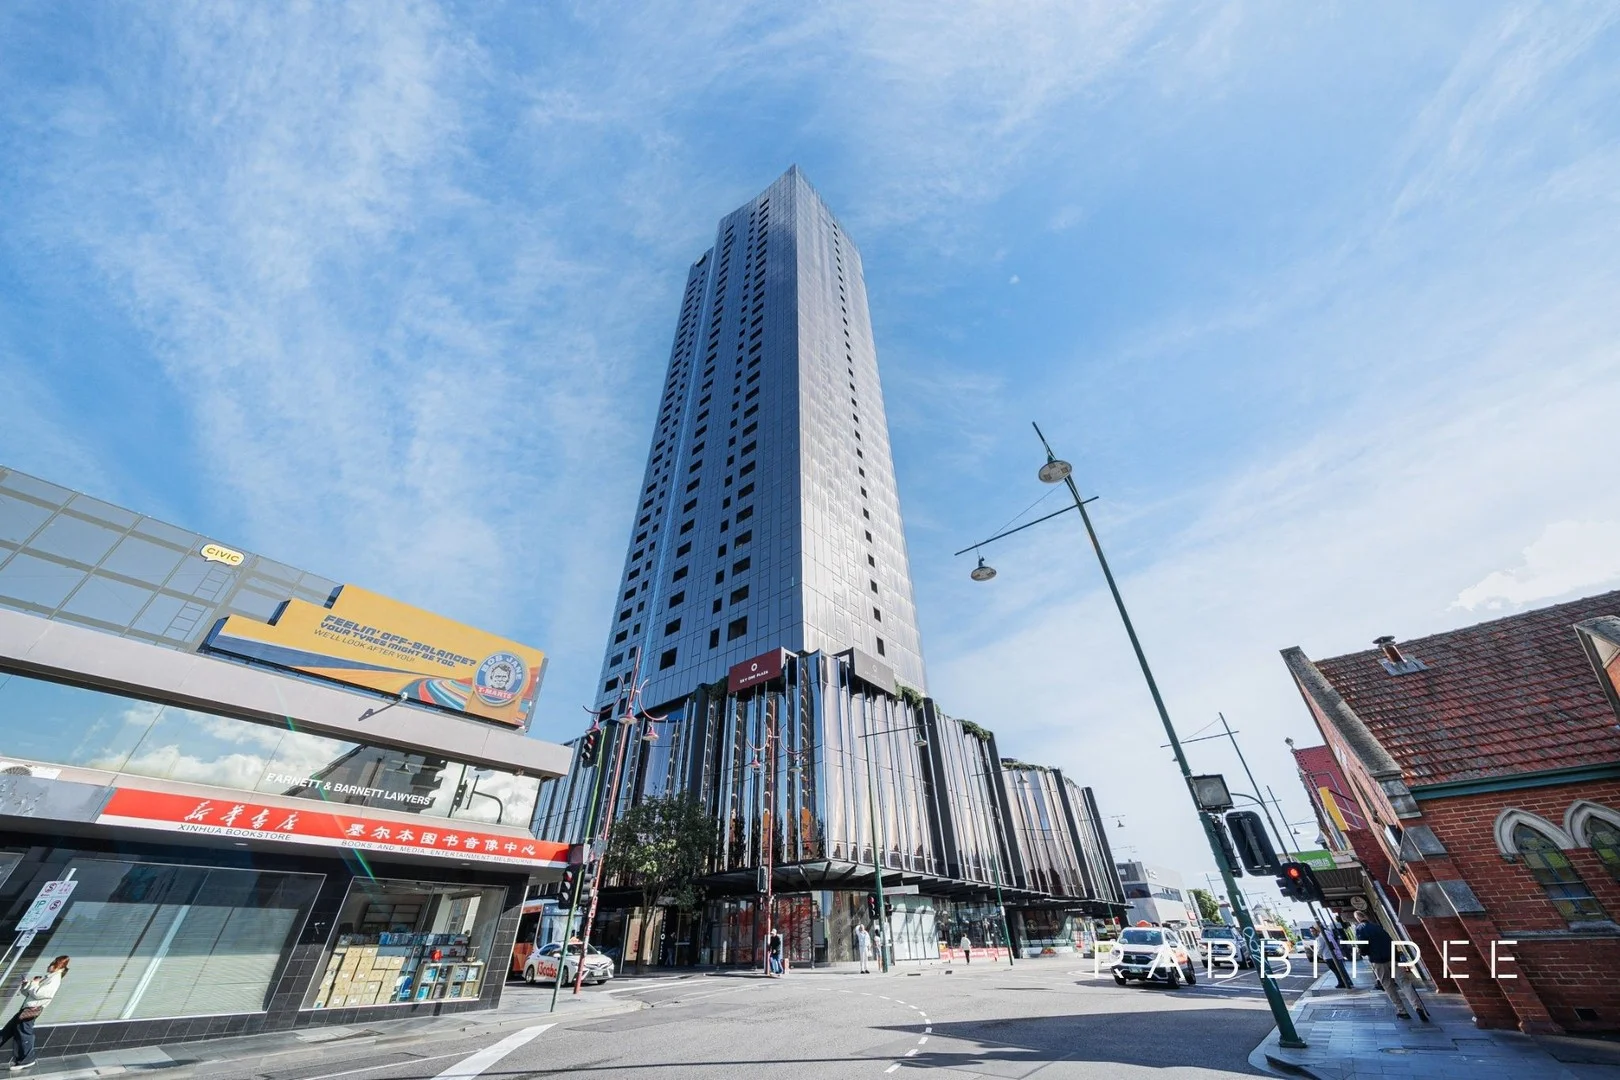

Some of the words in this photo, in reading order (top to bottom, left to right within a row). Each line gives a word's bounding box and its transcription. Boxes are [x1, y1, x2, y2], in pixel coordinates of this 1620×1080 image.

[206, 547, 240, 562] CIVIC
[320, 621, 351, 636] YOUR
[353, 631, 387, 647] TYRES
[388, 642, 421, 656] MIGHT
[421, 653, 435, 661] BE
[436, 656, 455, 667] TOO.
[324, 614, 380, 636] FEELIN'
[380, 632, 477, 666] OFF-BALANCE?
[342, 637, 366, 649] LOOK
[367, 646, 395, 657] AFTER
[480, 654, 503, 673] BOB
[505, 656, 523, 680] JANE
[265, 772, 323, 790] BARNETT
[323, 781, 332, 790] &
[333, 782, 384, 798] BARNETT
[384, 790, 432, 806] LAWYERS
[178, 823, 225, 835] XINHUA
[225, 828, 292, 841] BOOKSTORE
[345, 823, 537, 856] 墨尔本图书音像中心
[341, 839, 373, 849] BOOKS
[399, 846, 425, 854] MEDIA
[430, 848, 491, 861] ENTERTAINMENT
